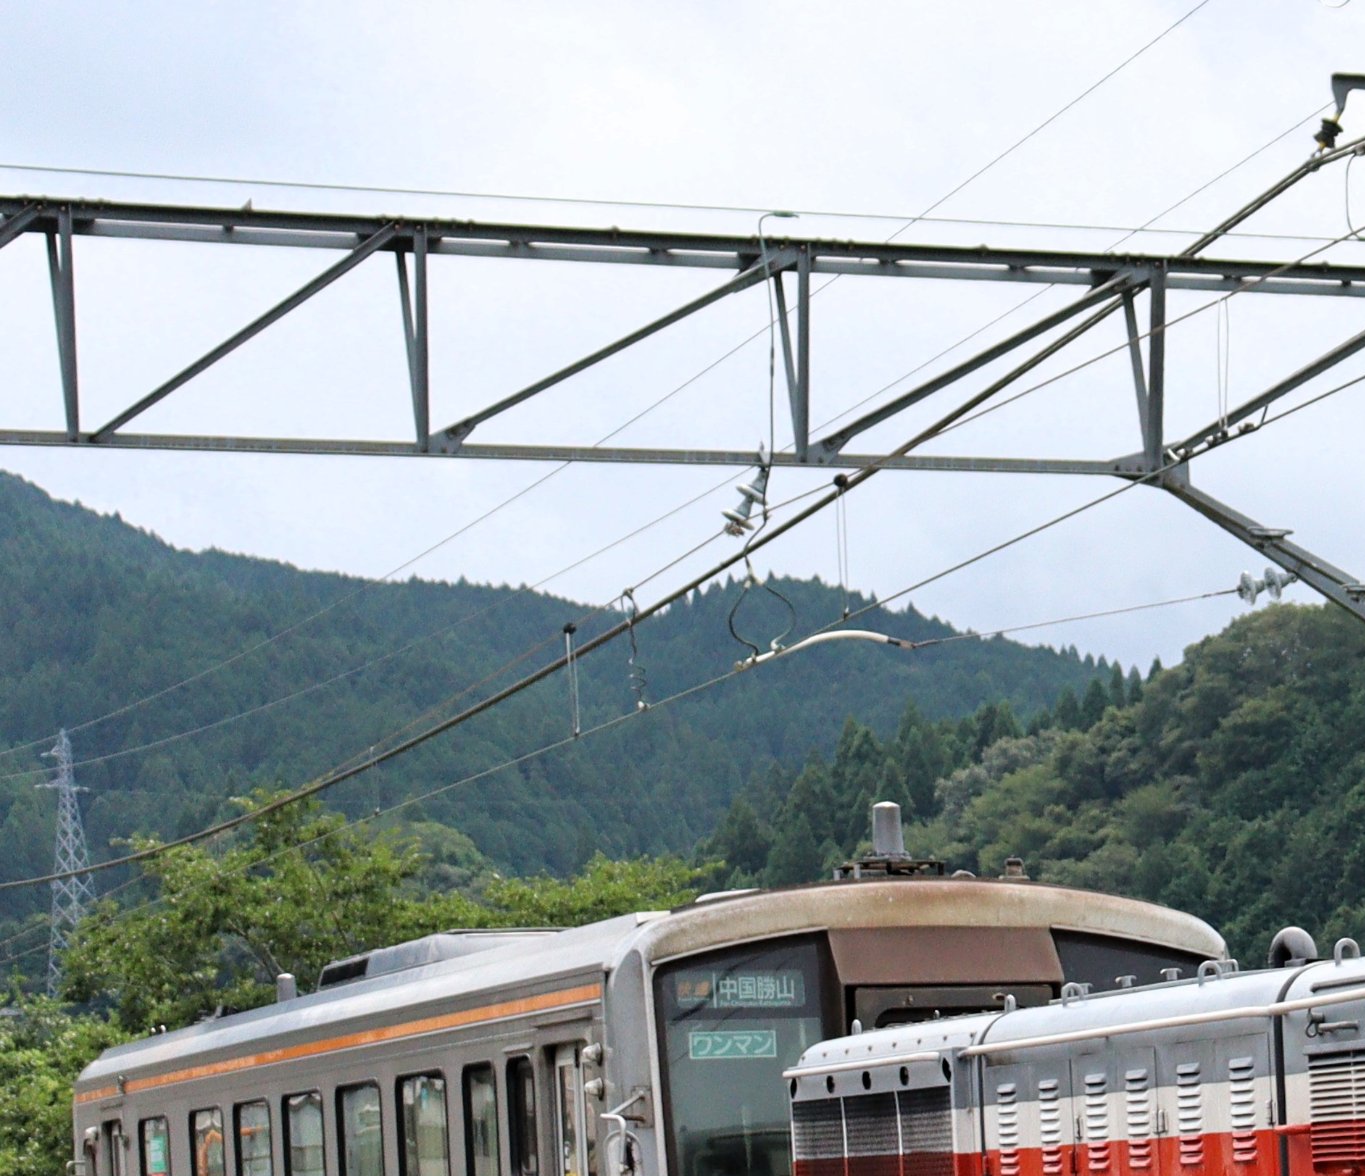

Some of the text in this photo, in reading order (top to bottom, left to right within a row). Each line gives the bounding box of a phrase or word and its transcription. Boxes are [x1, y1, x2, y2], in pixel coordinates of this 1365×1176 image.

[719, 975, 795, 1000] 中国勝山
[692, 1035, 773, 1056] ワンマン
